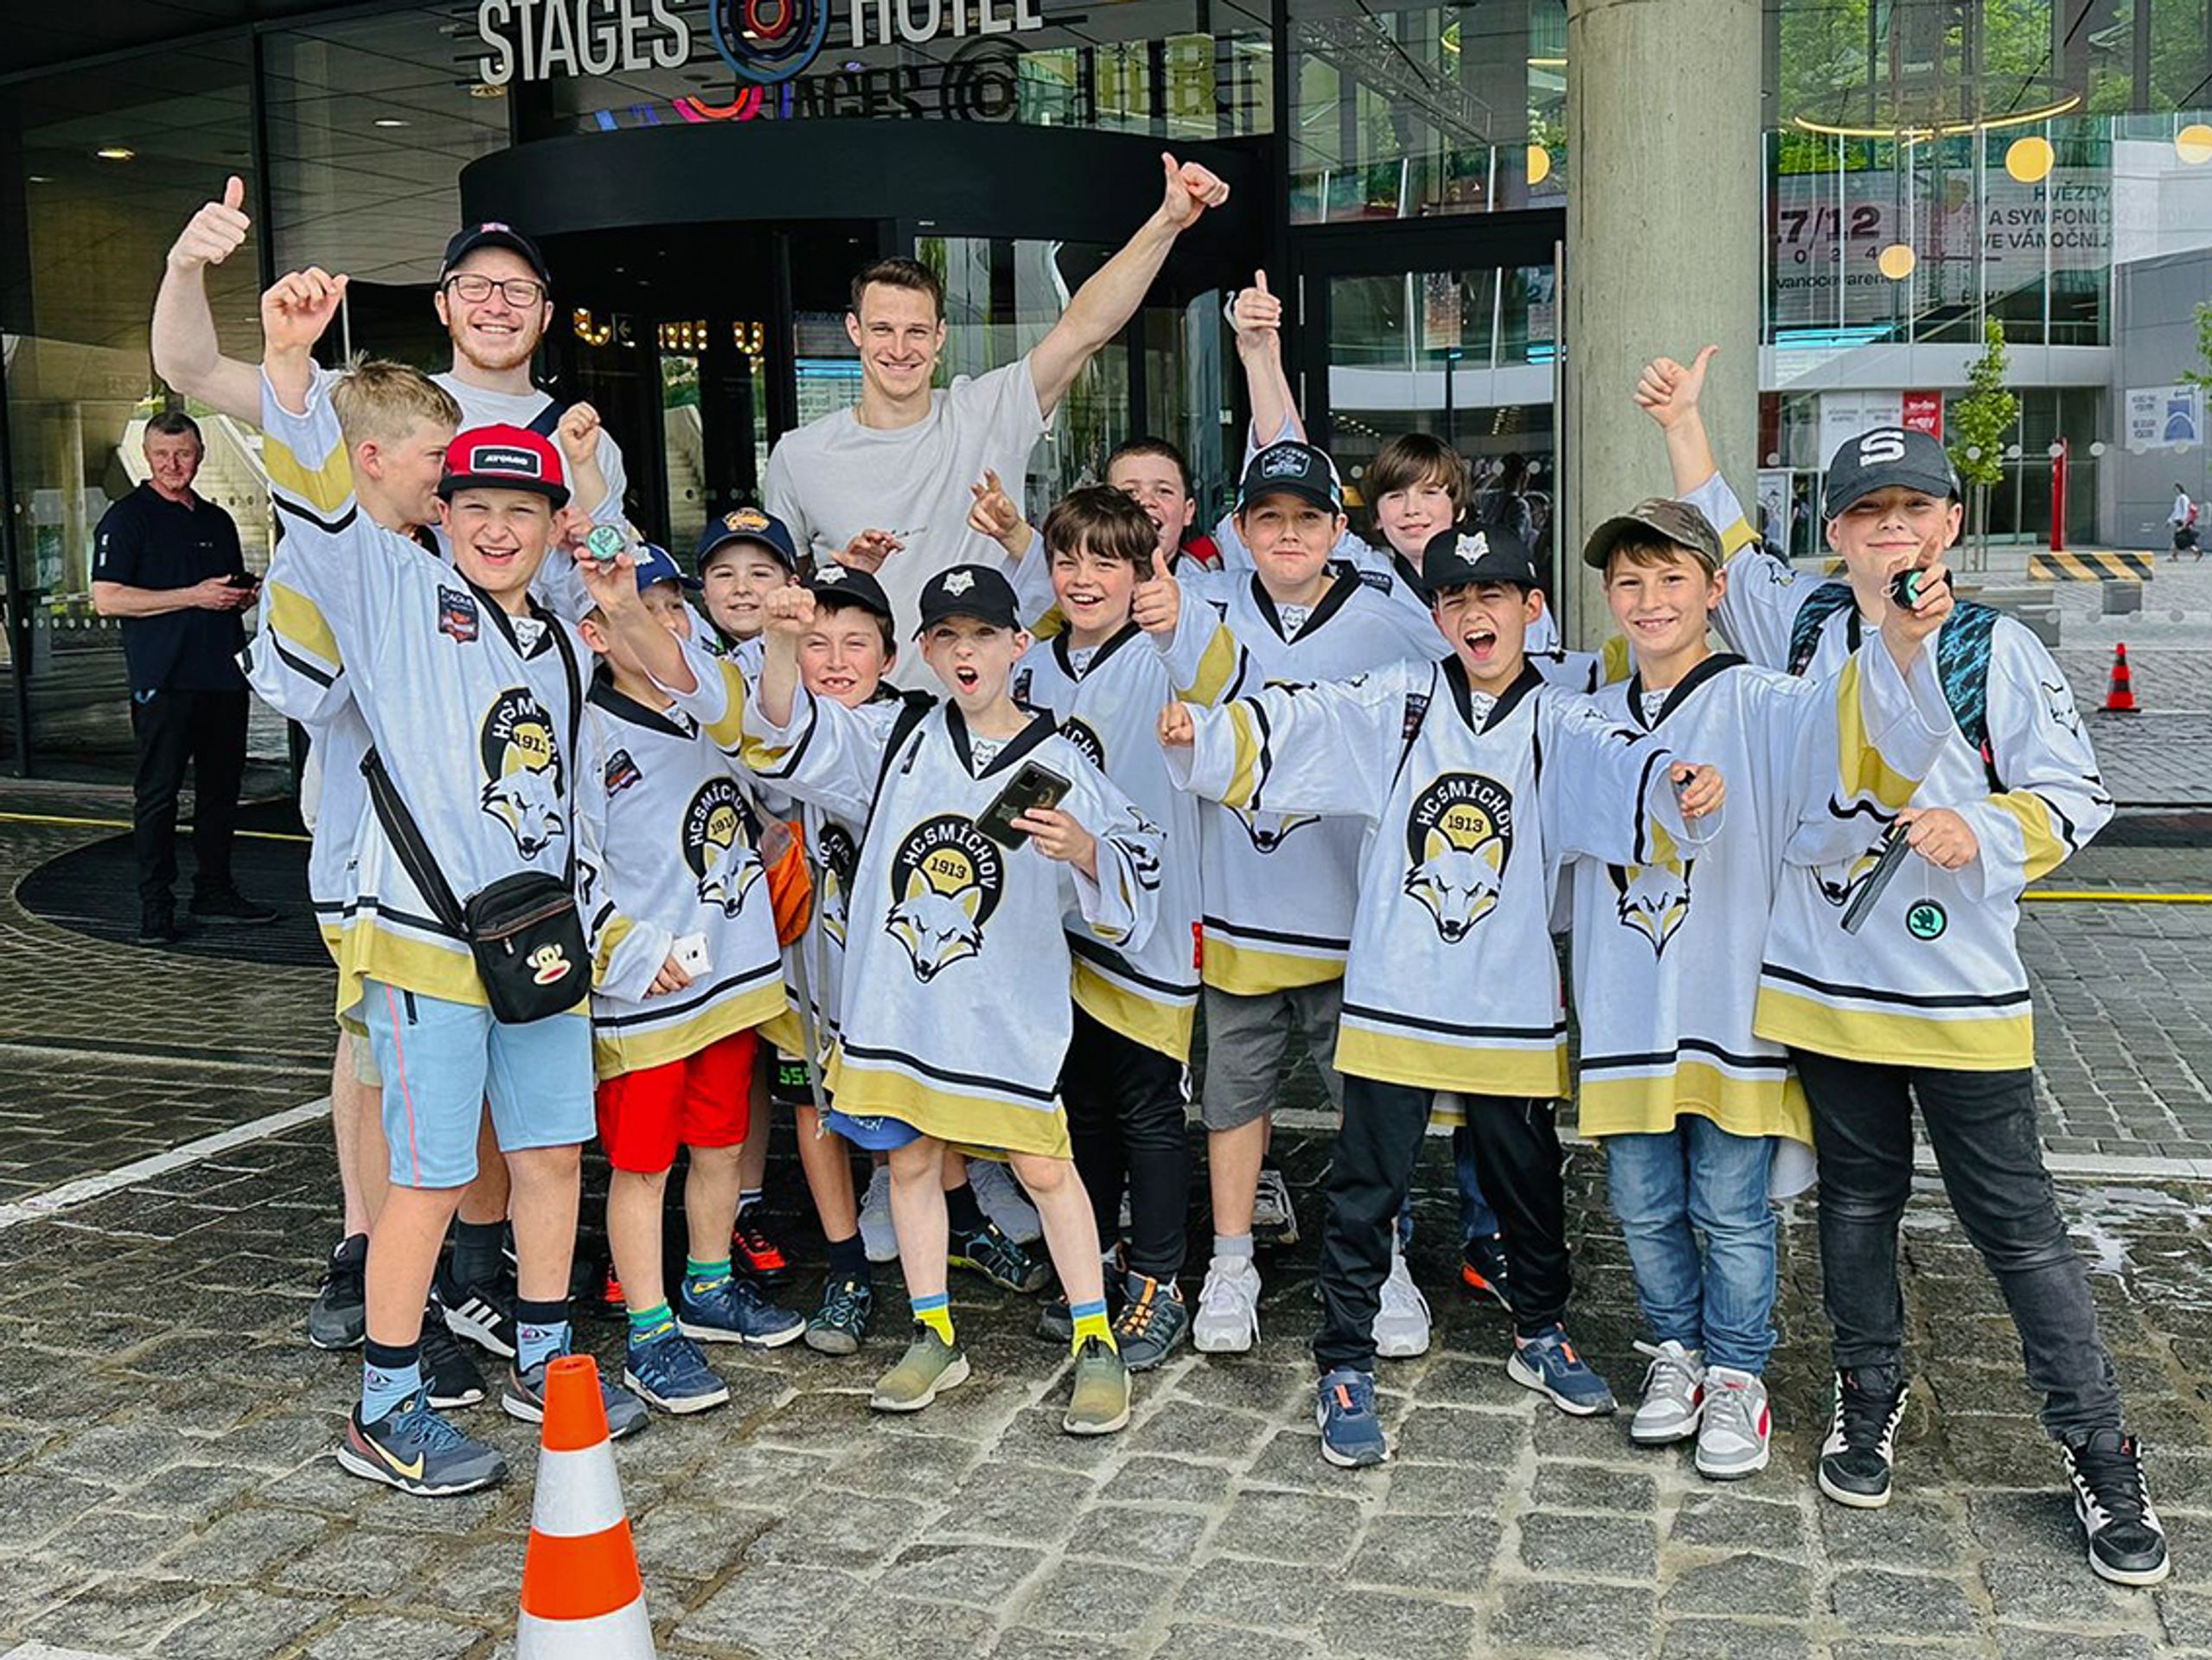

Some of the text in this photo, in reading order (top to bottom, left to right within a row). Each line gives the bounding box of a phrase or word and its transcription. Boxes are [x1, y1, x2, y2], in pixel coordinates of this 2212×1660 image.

[478, 0, 689, 86] STAGES
[1777, 207, 1879, 250] 7/12
[1448, 814, 1484, 833] 1913
[930, 858, 967, 879] 1913
